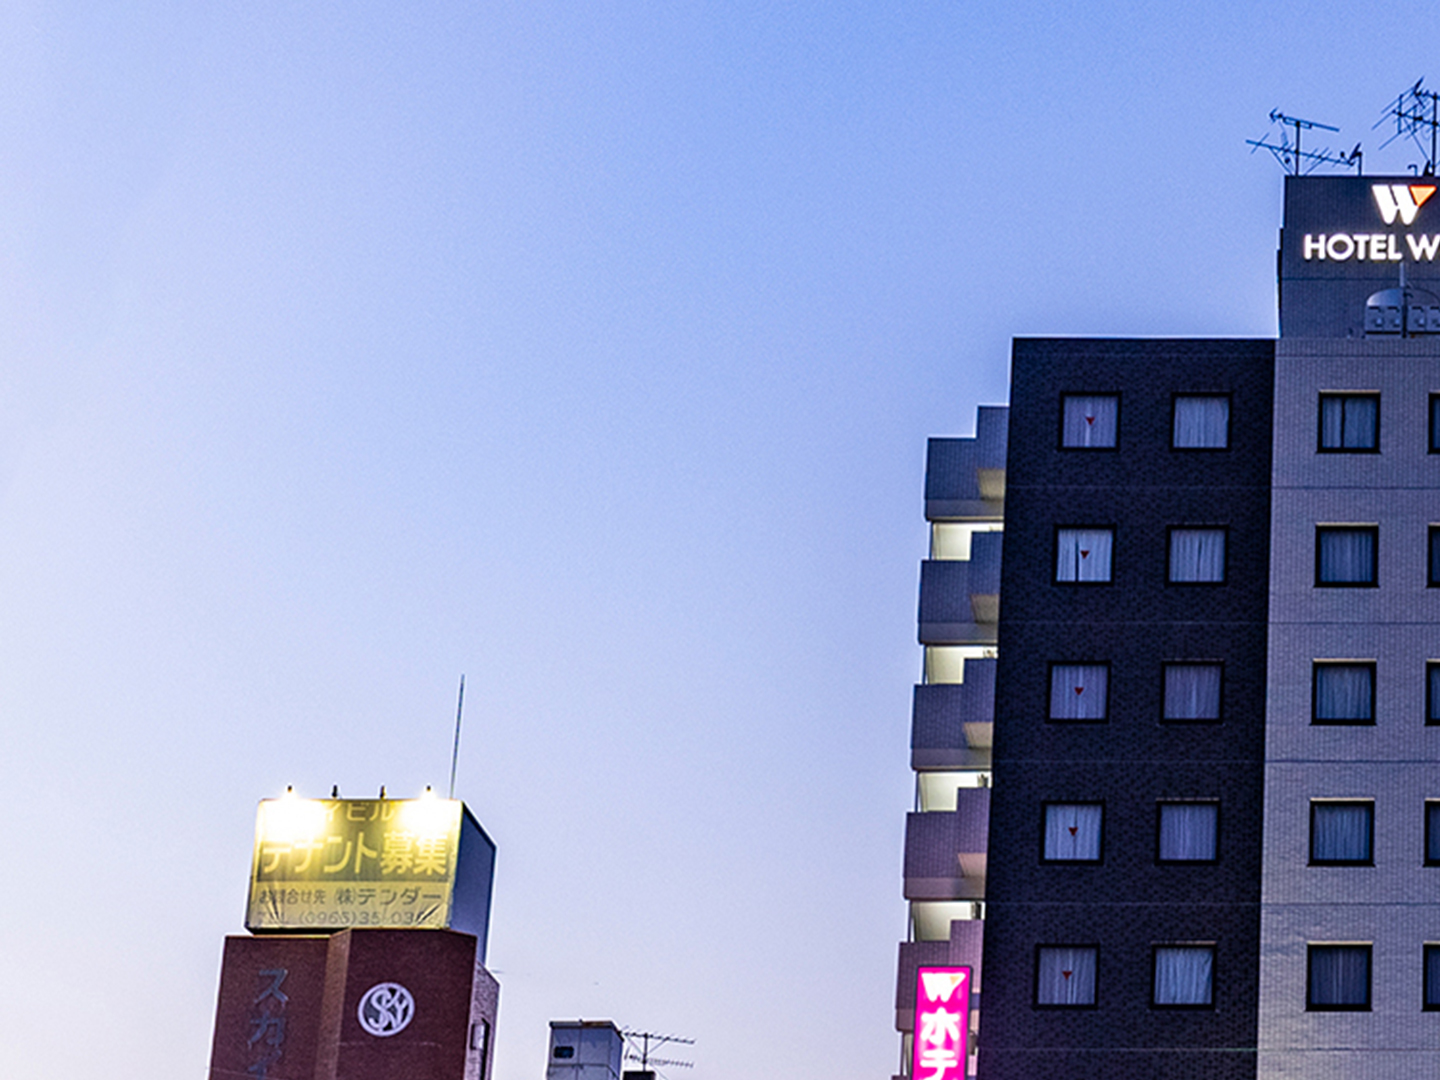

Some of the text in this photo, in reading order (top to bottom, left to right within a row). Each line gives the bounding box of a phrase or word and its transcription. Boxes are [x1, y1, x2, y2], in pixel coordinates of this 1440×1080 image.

[1304, 233, 1403, 261] HOTEL
[263, 831, 448, 875] テナント募集
